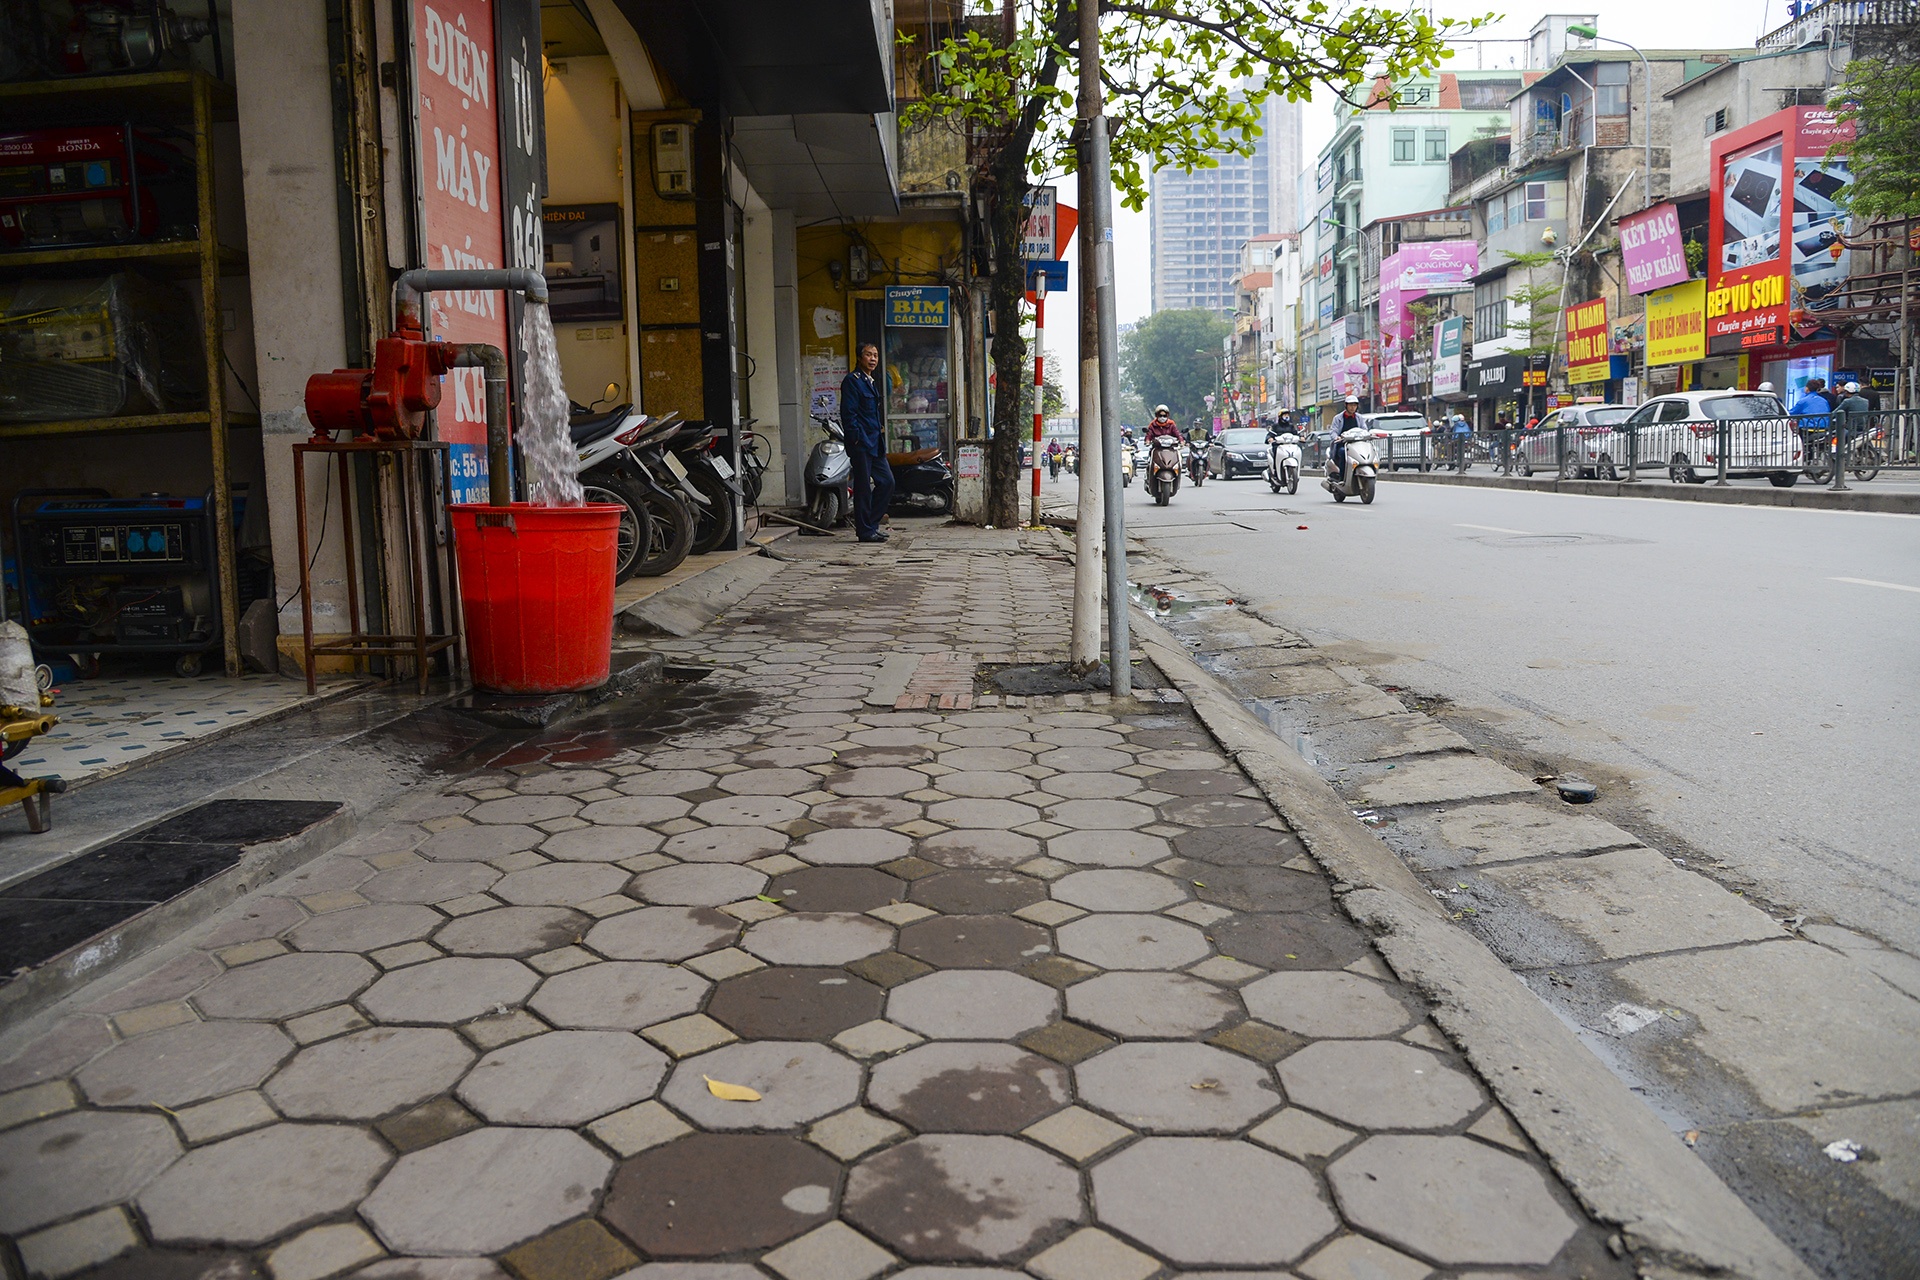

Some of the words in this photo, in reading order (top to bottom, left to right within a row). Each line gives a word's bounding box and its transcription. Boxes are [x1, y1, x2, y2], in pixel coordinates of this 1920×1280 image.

[425, 5, 489, 110] ĐIỆN
[511, 36, 533, 156] TỦ
[58, 143, 100, 152] HONDA
[434, 124, 490, 213] MÁY
[568, 211, 586, 222] ĐẠI
[1622, 219, 1646, 251] KÉT
[1648, 212, 1676, 245] BẠC
[441, 235, 494, 320] NÉN
[1628, 259, 1653, 287] NHẬP
[1655, 245, 1682, 279] KHẨU
[889, 288, 922, 298] Chuyên
[893, 296, 945, 314] BỈM
[1707, 276, 1732, 319] BẾP
[1731, 274, 1751, 313] VŨ
[1751, 274, 1785, 310] SƠN
[894, 314, 916, 324] CÁC
[919, 315, 943, 326] LOẠI
[1567, 310, 1576, 333] IN
[1577, 302, 1605, 331] NHANH
[1717, 320, 1740, 334] Chuyên
[1741, 319, 1753, 331] gia
[1754, 313, 1767, 328] bếp
[1569, 331, 1591, 362] ĐỒNG
[1593, 332, 1607, 361] LỢI
[1479, 366, 1506, 387] MALIBU
[453, 367, 487, 424] KH
[1547, 396, 1557, 407] 122
[462, 453, 477, 478] 55
